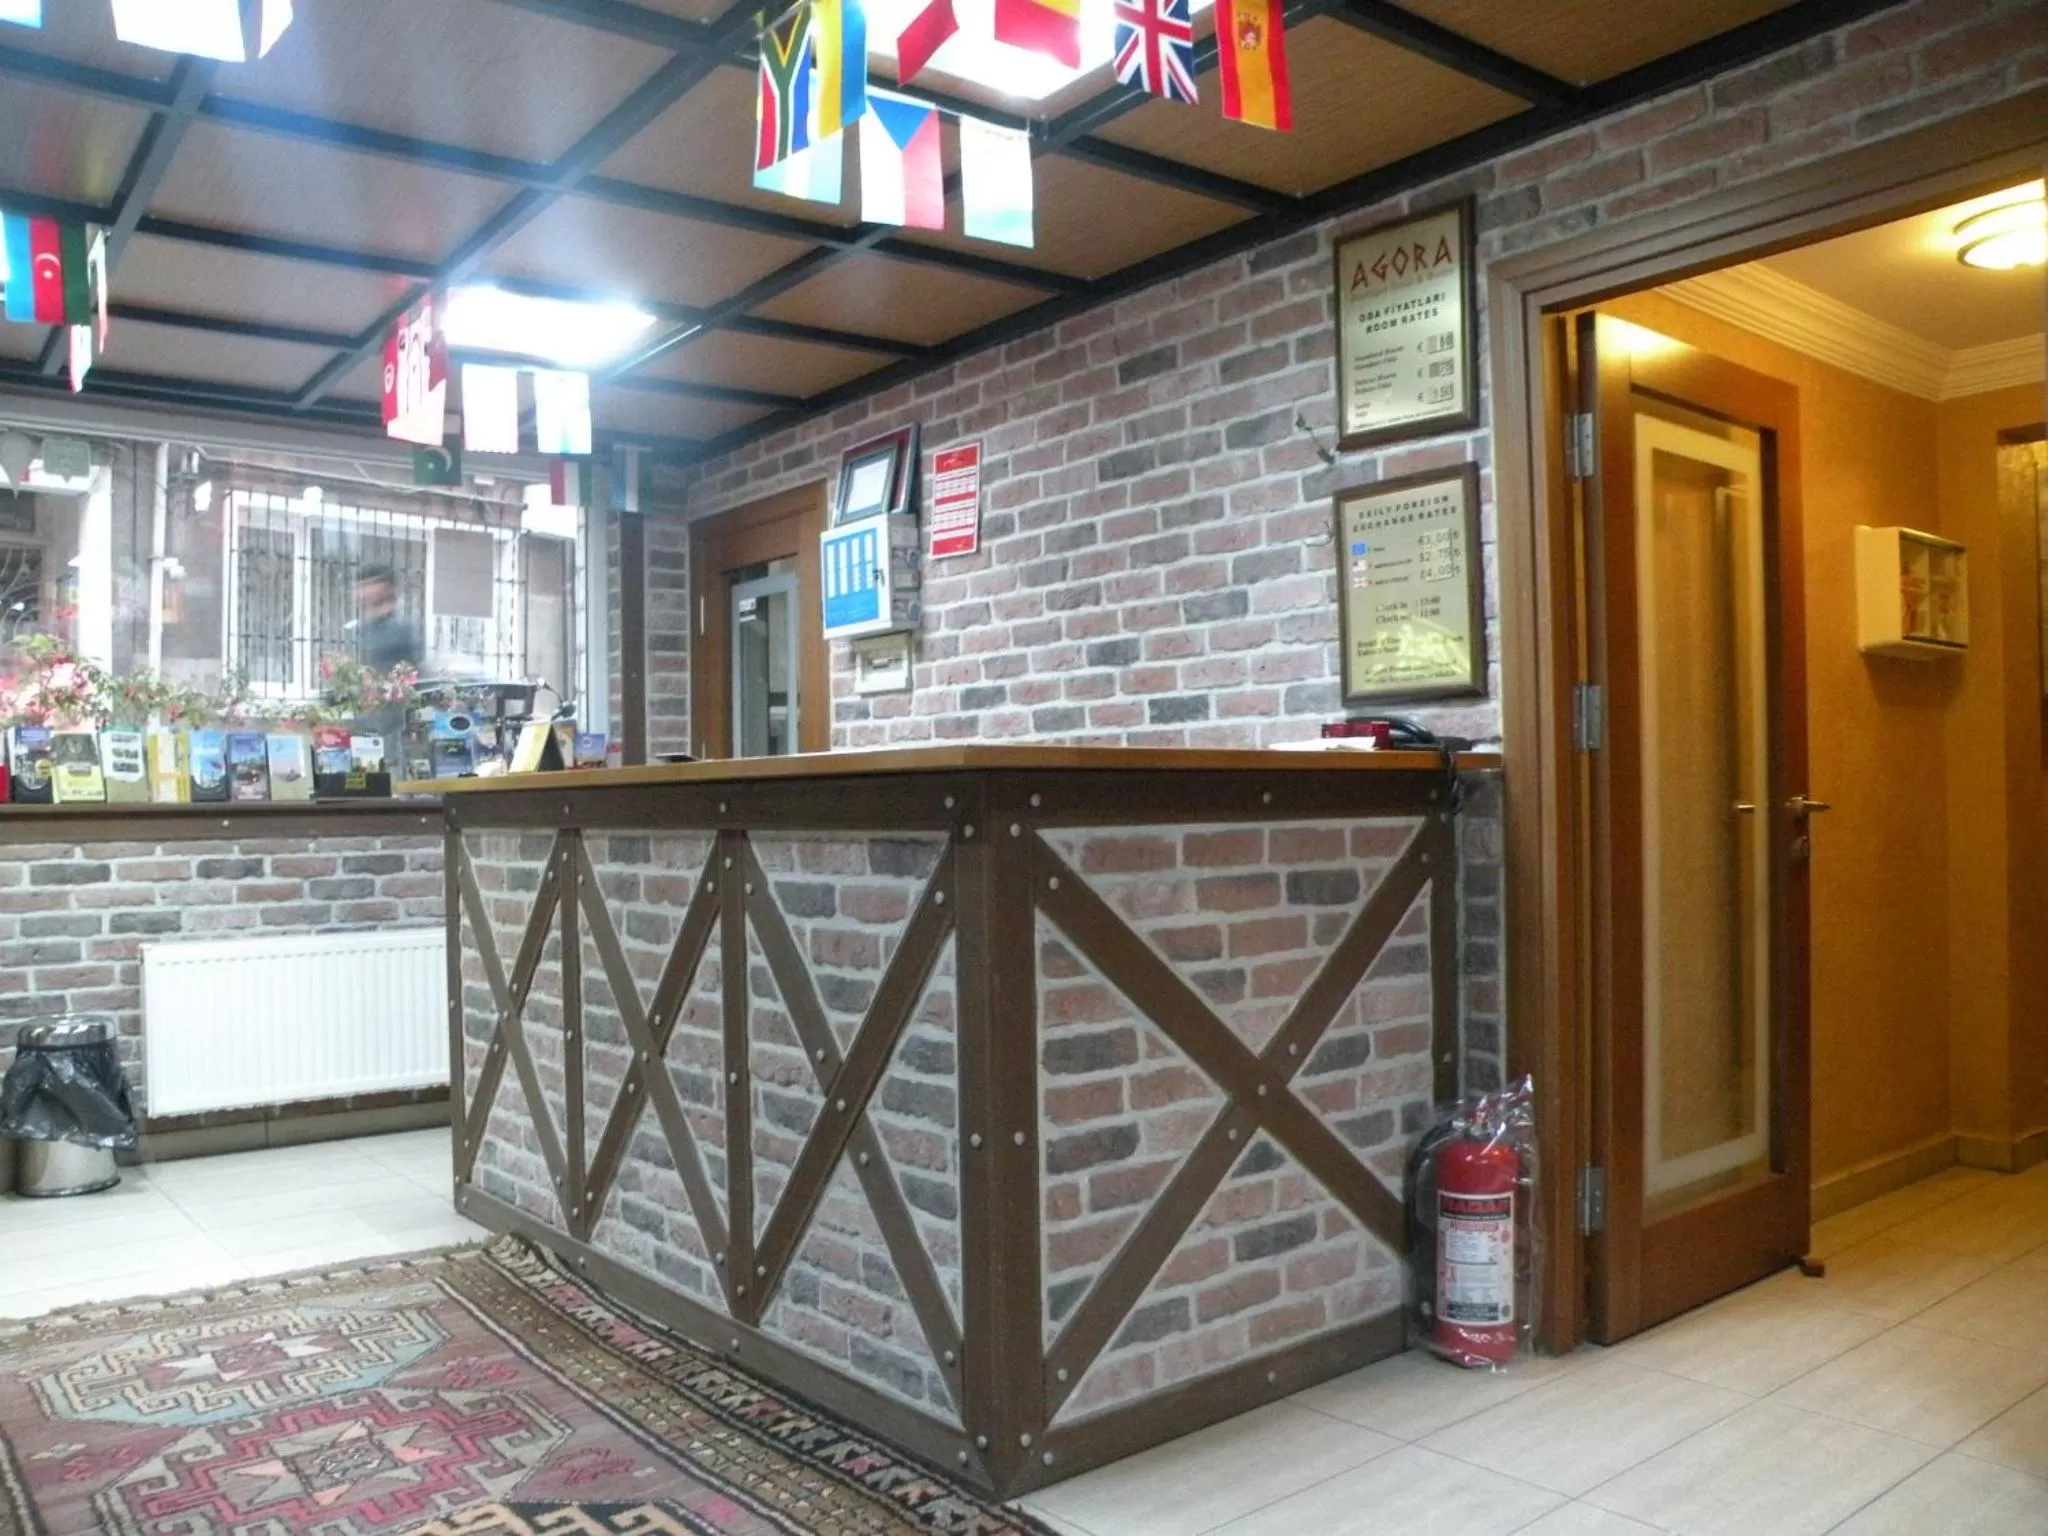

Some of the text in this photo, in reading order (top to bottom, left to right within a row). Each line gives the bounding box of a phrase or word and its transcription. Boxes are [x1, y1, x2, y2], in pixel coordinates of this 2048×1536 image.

[1351, 235, 1453, 292] AGORA
[1366, 307, 1439, 334] ROOM RATES
